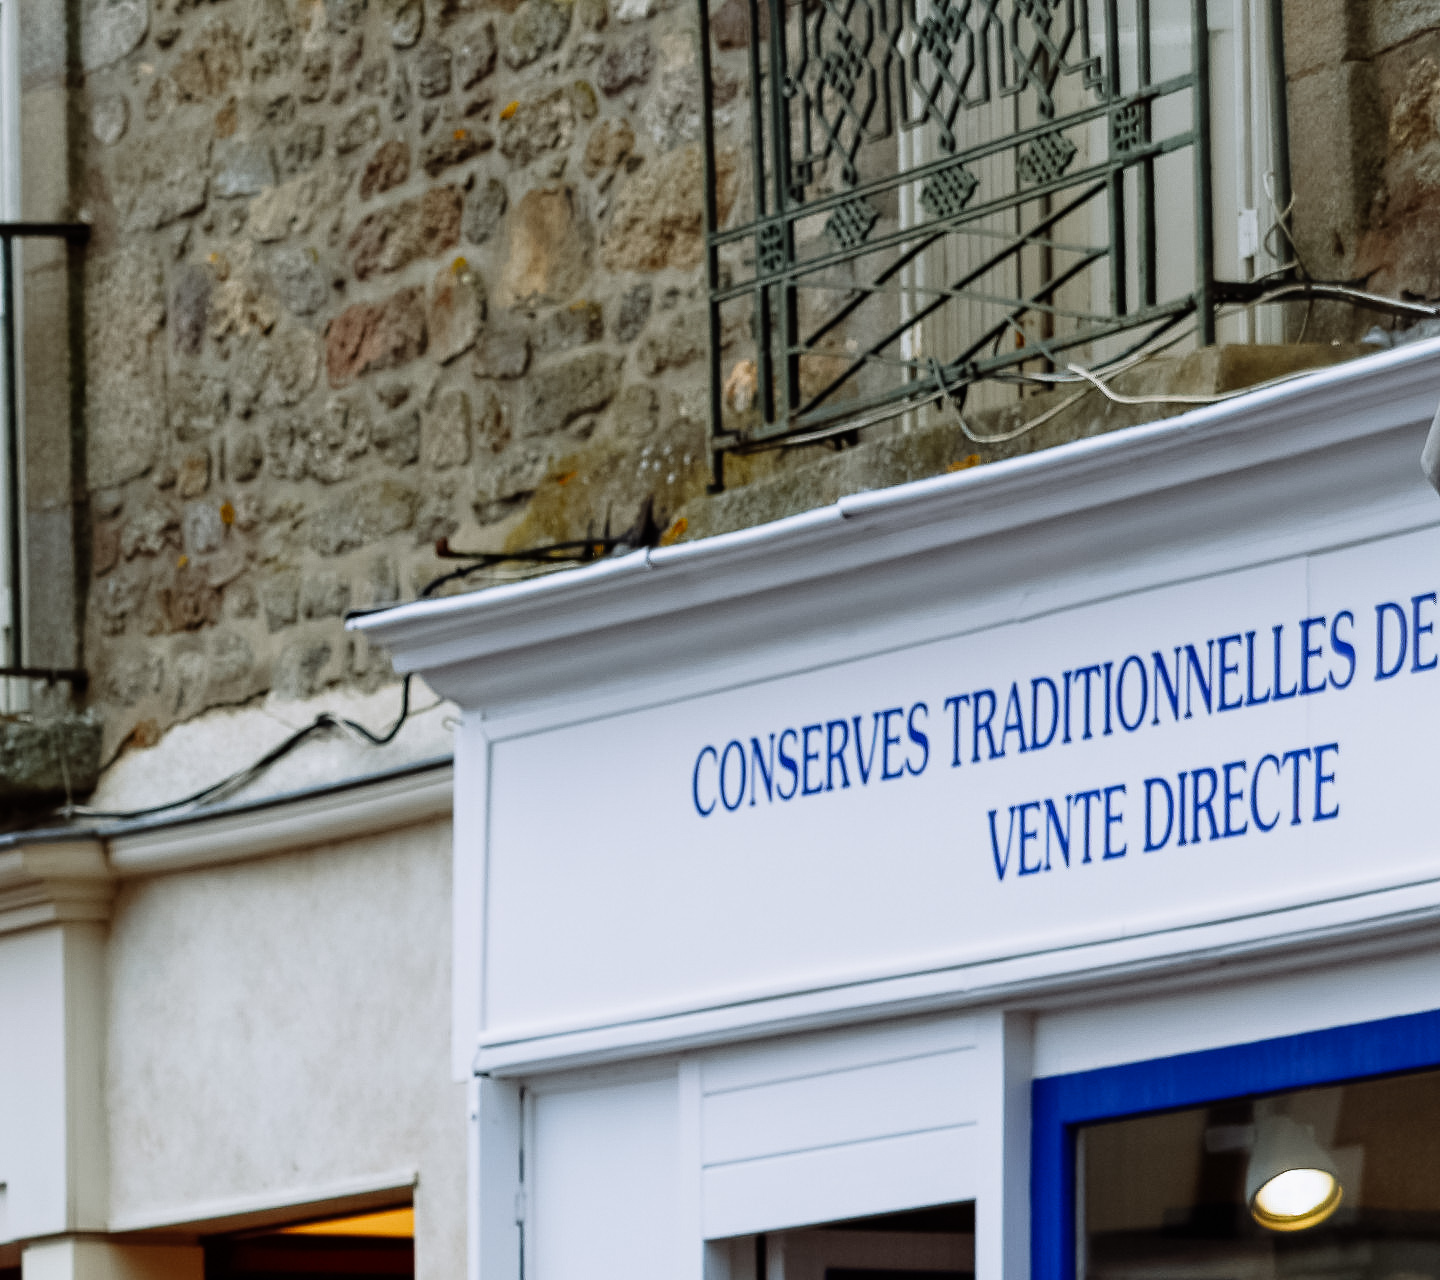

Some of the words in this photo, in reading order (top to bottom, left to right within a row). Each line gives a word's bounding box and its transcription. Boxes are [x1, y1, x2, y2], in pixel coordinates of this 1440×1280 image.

[692, 700, 931, 818] CONSERVES
[943, 609, 1358, 768] TRADITIONNELLES
[1374, 591, 1439, 682] DE
[987, 783, 1128, 881] VENTE
[1143, 741, 1341, 853] DIRECTE
